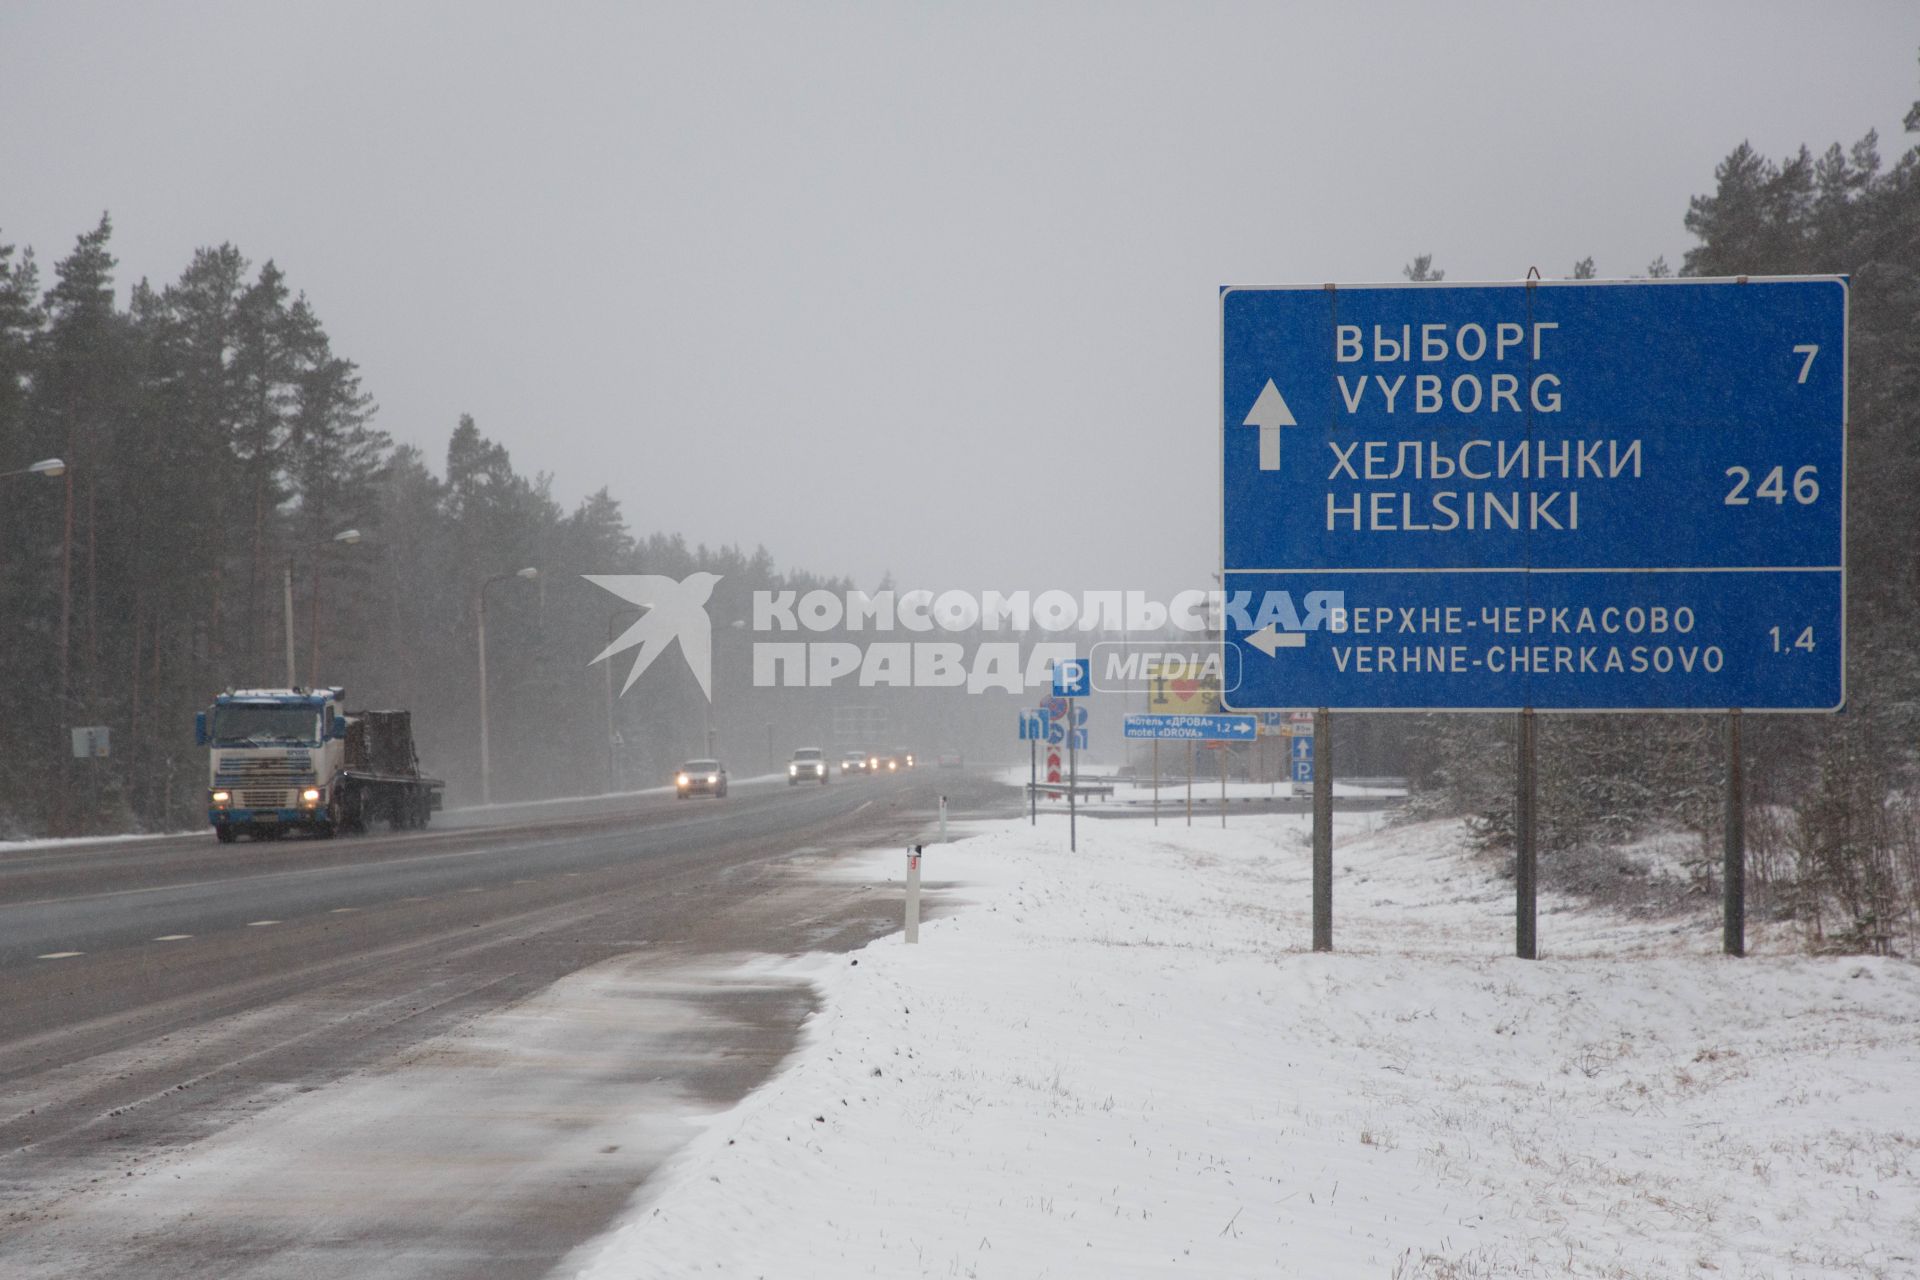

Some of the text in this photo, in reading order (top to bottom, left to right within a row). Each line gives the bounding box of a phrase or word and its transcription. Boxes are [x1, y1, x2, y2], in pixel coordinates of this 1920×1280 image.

[1336, 322, 1559, 362] ВЫБОРГ
[1793, 344, 1819, 384] 7
[1336, 373, 1562, 414] VYBORG
[1327, 439, 1642, 480] ХЕЛЬСИНКИ
[1724, 465, 1820, 506] 246
[1326, 491, 1578, 531] HELSINKI
[1331, 606, 1695, 634] ВЕРХНЕ-ЧЕРКАСОВО
[1332, 645, 1724, 673] VERHNE-CHERKASOVO
[1769, 625, 1816, 656] 1,4
[1126, 727, 1157, 738] motel
